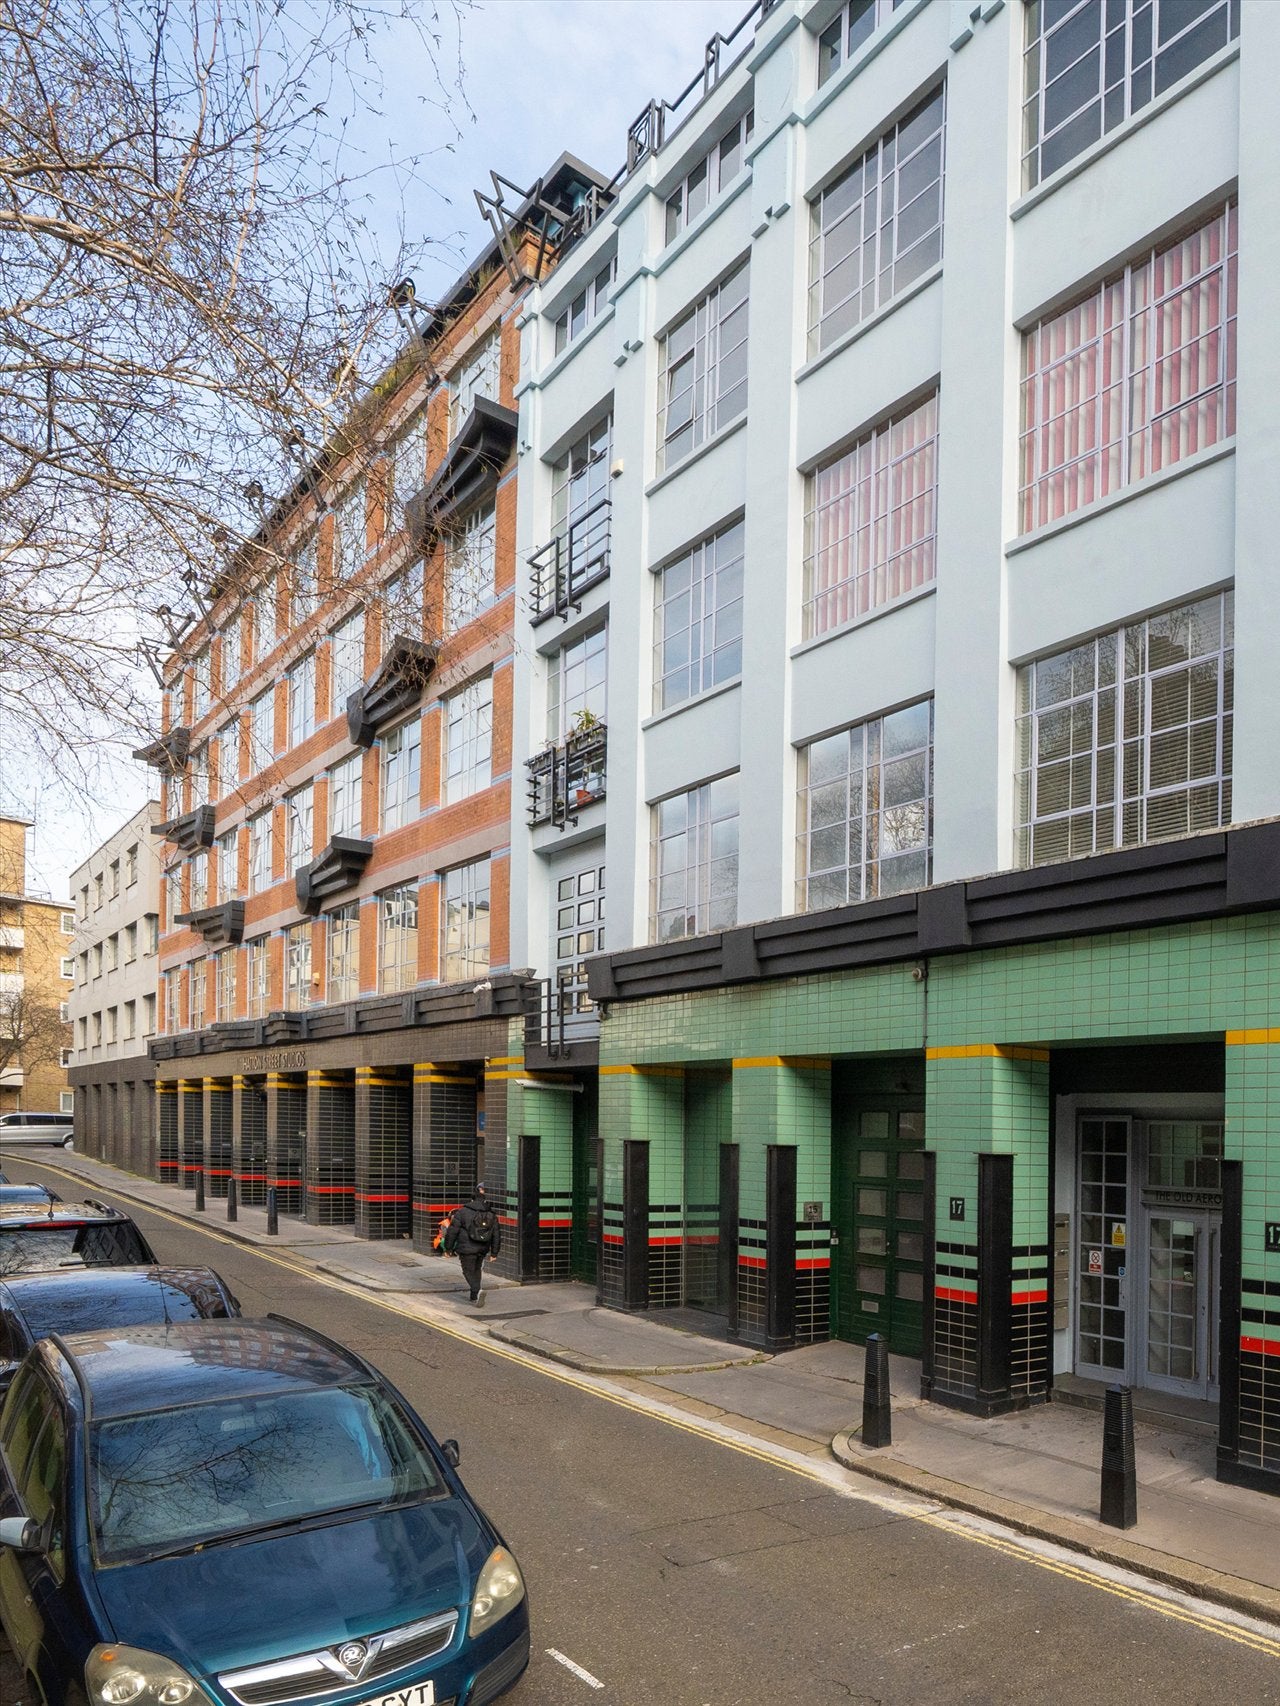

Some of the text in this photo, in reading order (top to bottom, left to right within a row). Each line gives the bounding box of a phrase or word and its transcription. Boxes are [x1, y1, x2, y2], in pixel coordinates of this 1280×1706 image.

[1156, 1190, 1222, 1204] THE OLD AERO
[951, 1199, 963, 1214] 17
